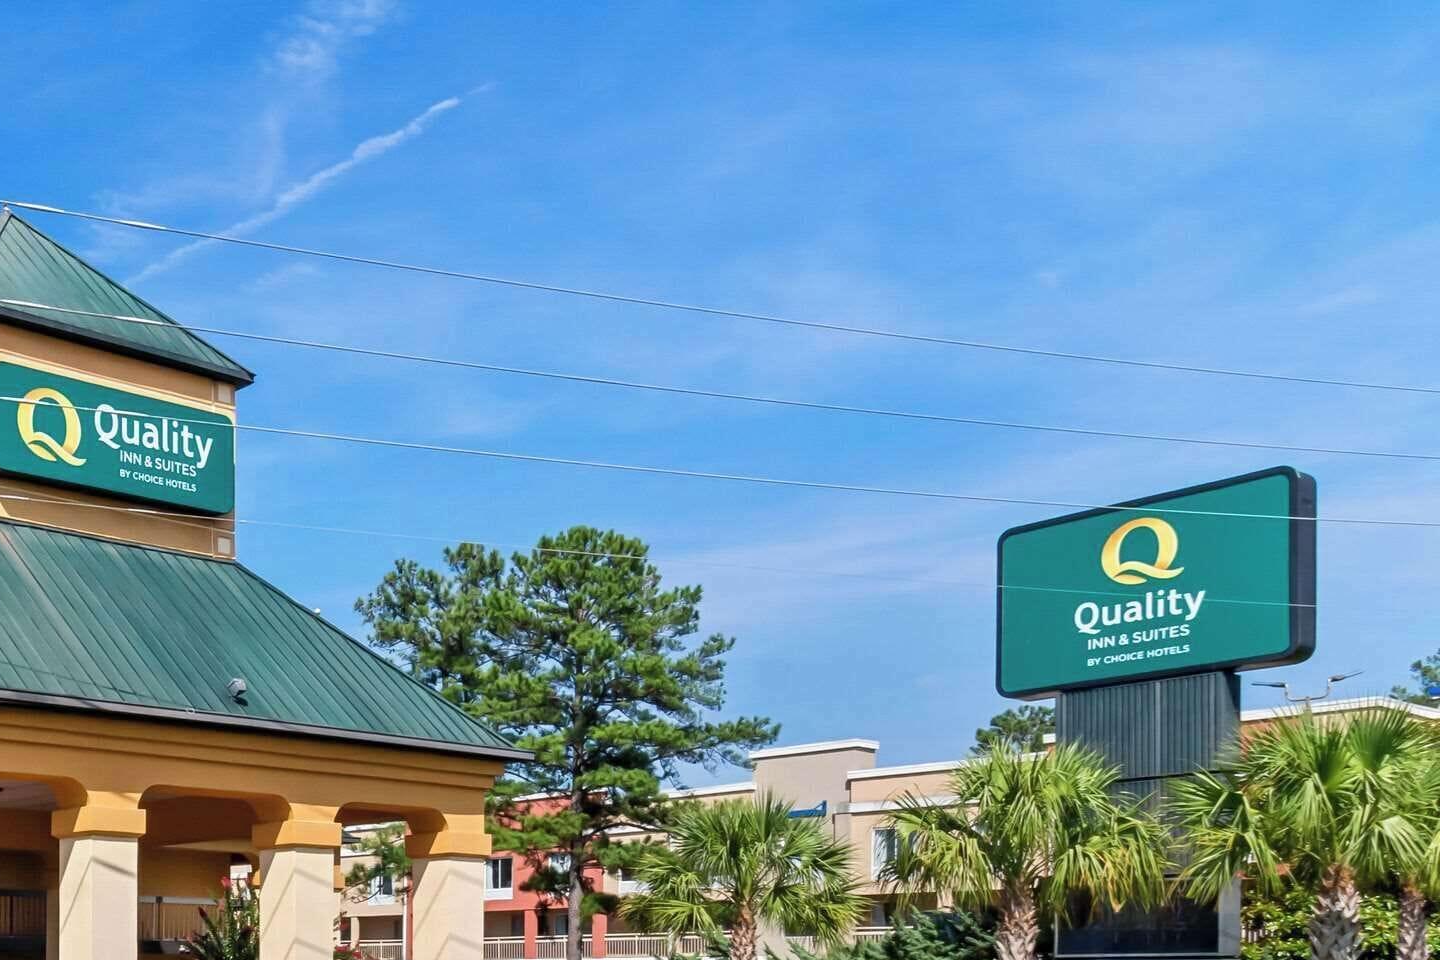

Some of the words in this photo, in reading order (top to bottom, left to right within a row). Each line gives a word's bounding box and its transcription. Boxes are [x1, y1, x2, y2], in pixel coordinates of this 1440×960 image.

[17, 387, 87, 467] Q
[94, 403, 214, 469] Quality
[120, 450, 142, 466] INN
[144, 456, 153, 468] &
[155, 457, 197, 477] SUITES
[120, 469, 131, 479] BY
[132, 471, 164, 486] CHOICE
[166, 478, 197, 493] HOTELS
[1101, 517, 1185, 585] Q
[1074, 589, 1206, 635] Quality
[1088, 636, 1116, 650] INN
[1118, 633, 1129, 646] &
[1132, 624, 1191, 643] SUITES
[1087, 657, 1102, 667] BY
[1103, 650, 1144, 664] CHOICE
[1146, 644, 1191, 658] HOTELS
